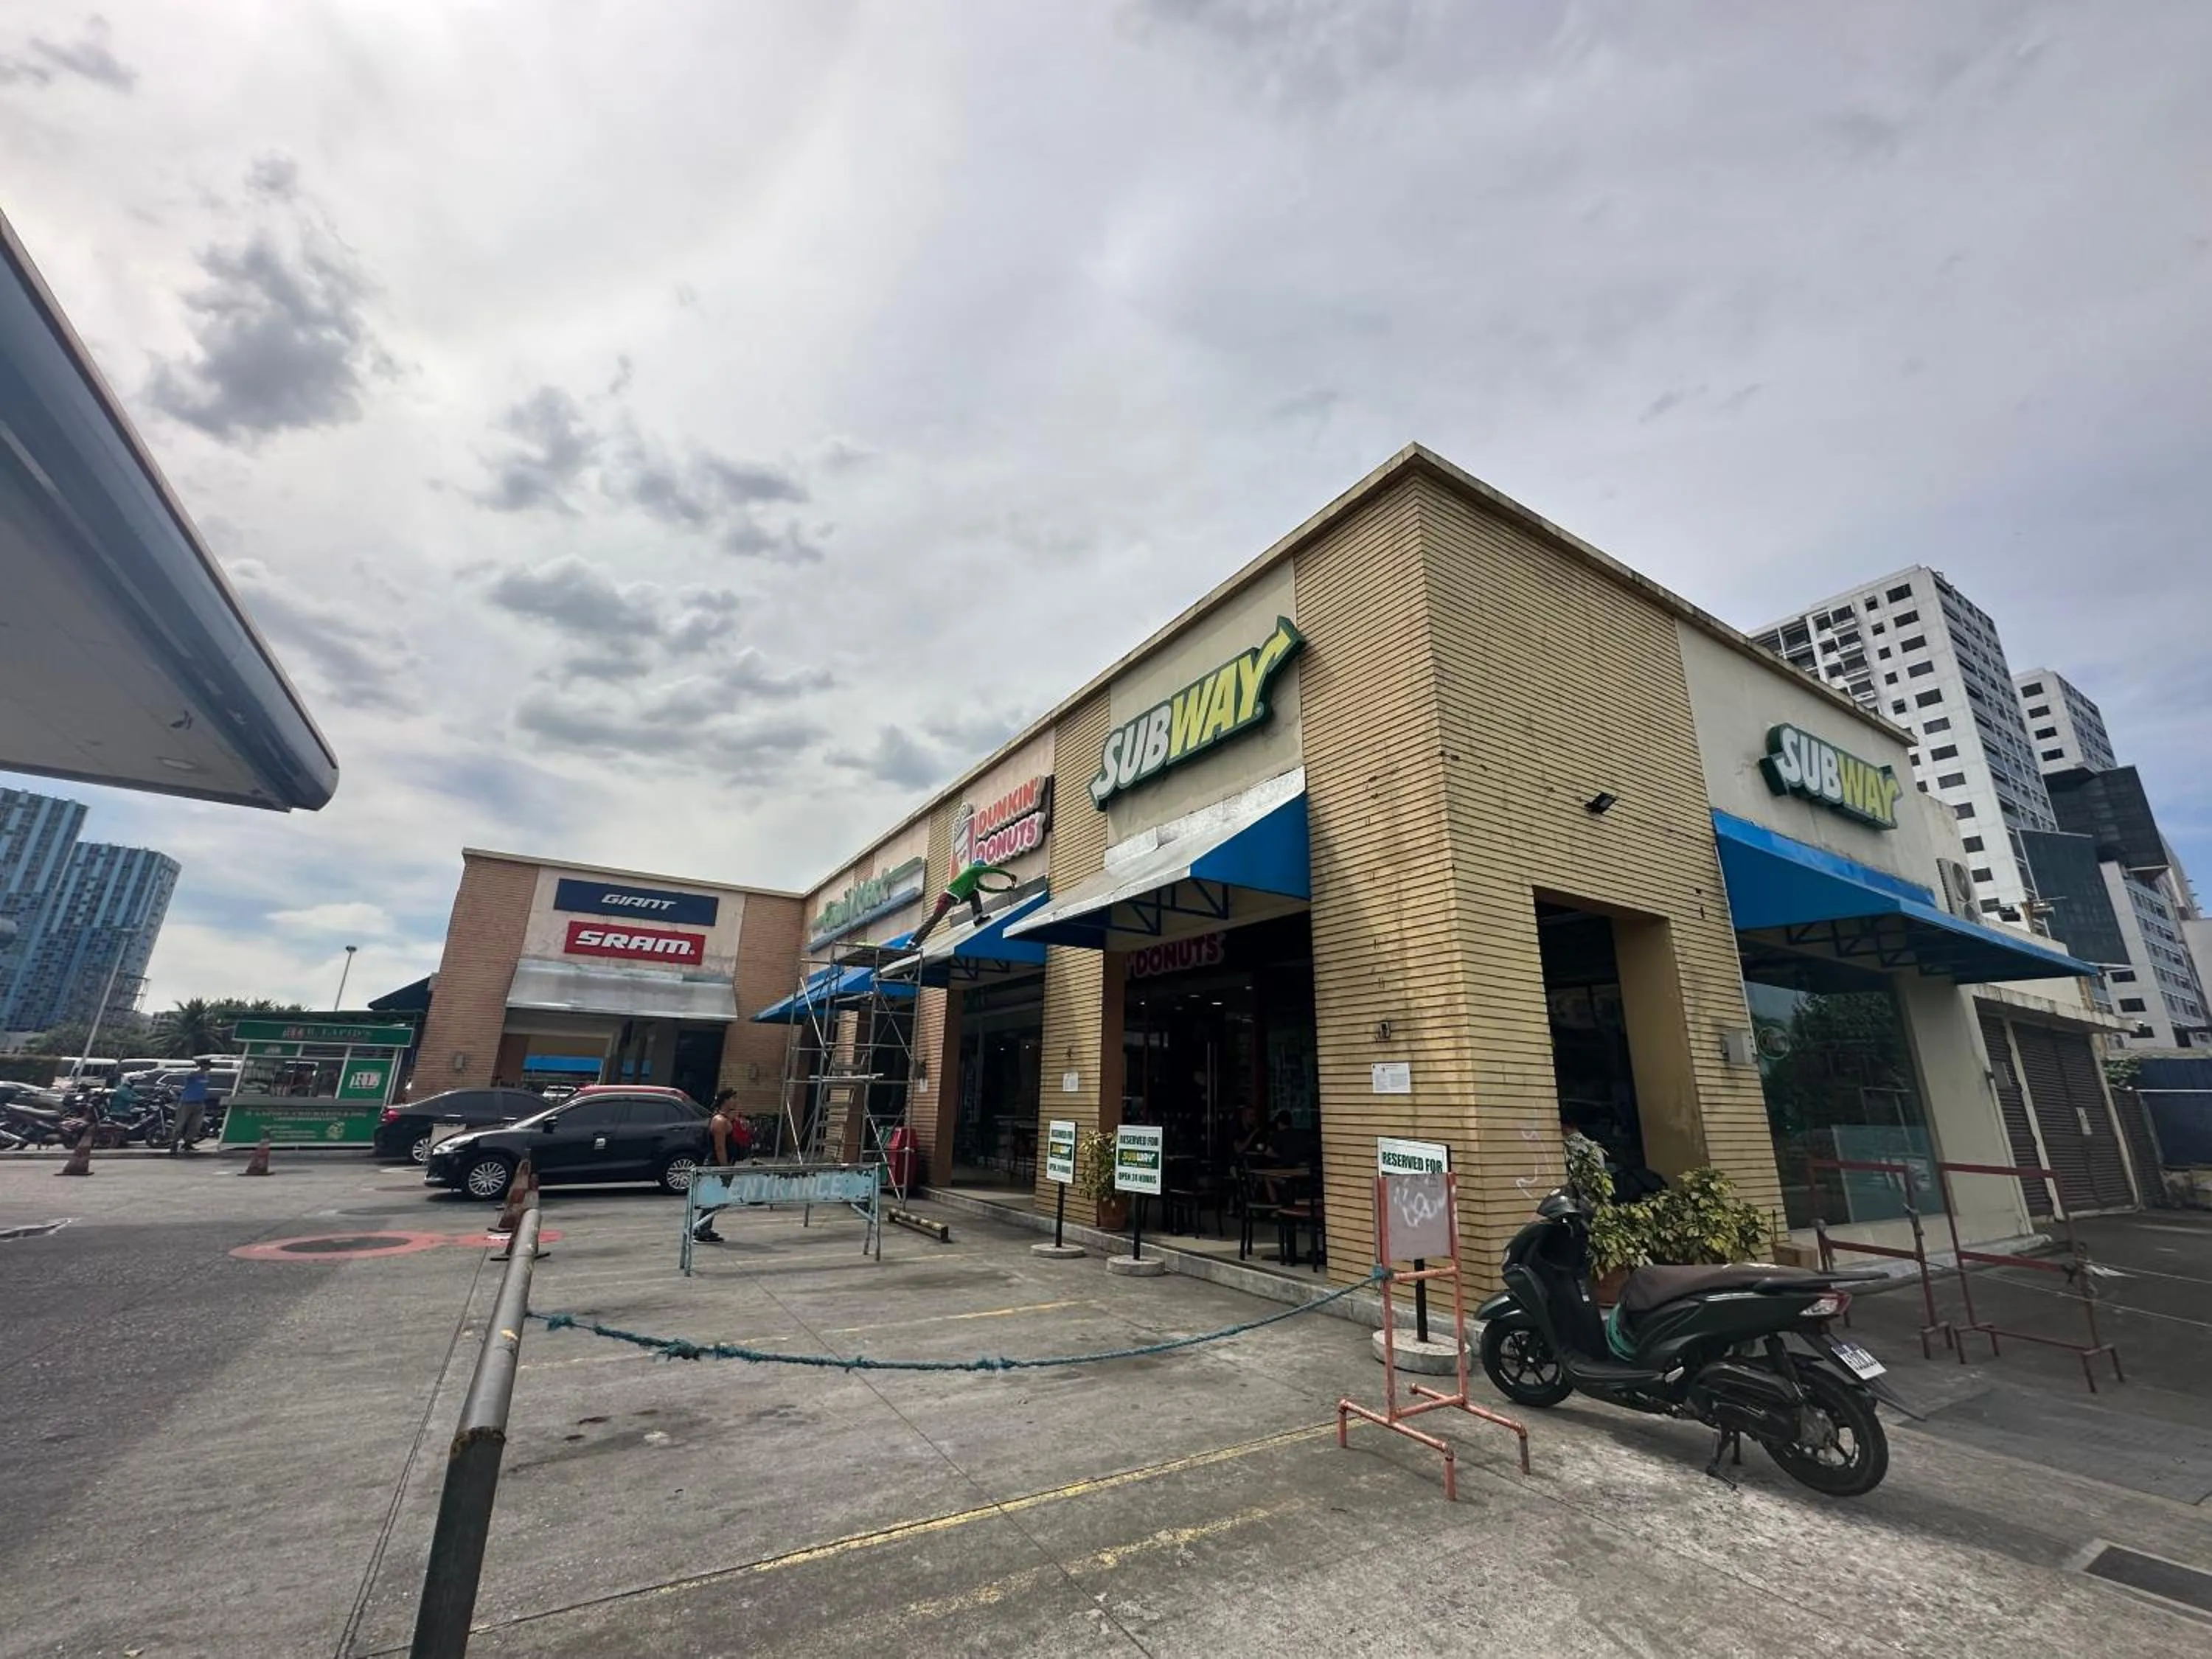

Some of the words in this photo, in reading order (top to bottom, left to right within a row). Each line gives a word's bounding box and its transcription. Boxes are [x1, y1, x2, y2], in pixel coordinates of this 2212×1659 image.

[1091, 628, 1291, 801] SUBWAY
[1775, 727, 1899, 824] SUBWAY
[977, 776, 1039, 838] DUNKIN'
[974, 816, 1037, 865] DONUTS
[601, 894, 678, 911] GIANT
[575, 930, 691, 955] SRAM
[1135, 932, 1220, 975] DONUTS
[1120, 1135, 1146, 1145] RESERVED
[1382, 1151, 1424, 1171] RESERVED
[1425, 1158, 1443, 1174] FOR
